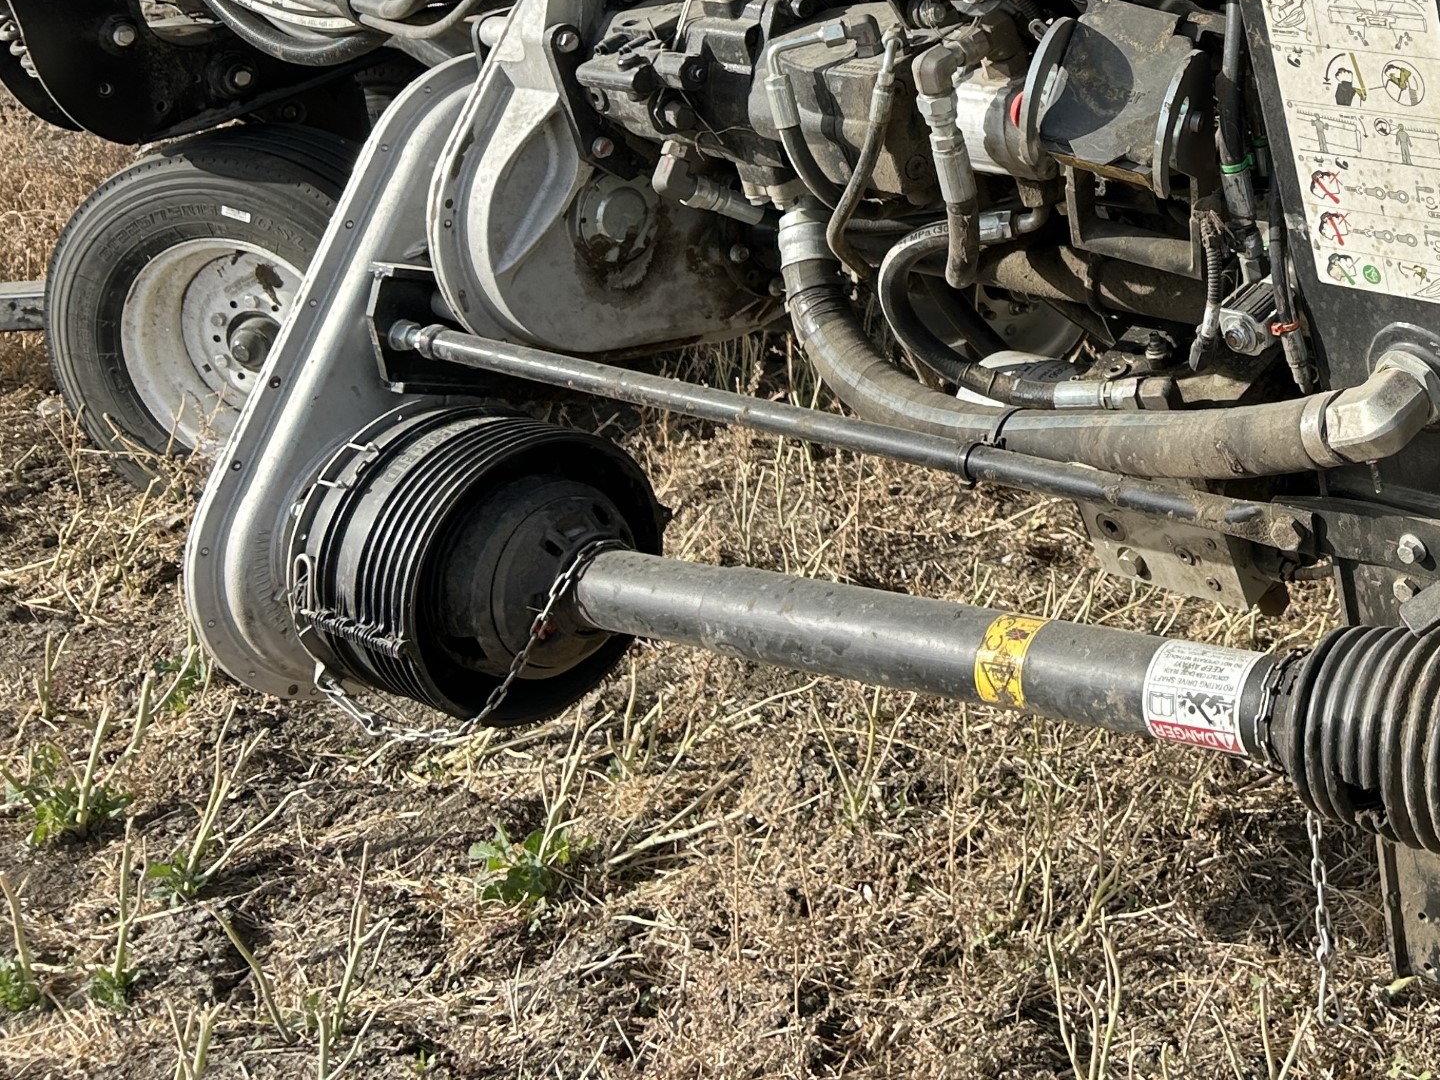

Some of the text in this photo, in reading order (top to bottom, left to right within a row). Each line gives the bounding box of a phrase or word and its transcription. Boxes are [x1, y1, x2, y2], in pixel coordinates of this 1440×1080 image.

[909, 230, 931, 242] MPa
[1193, 657, 1220, 665] OPERATE
[1173, 661, 1225, 674] KEEP AWAY!
[1153, 675, 1234, 692] ROTATING DRIVE SHAFT
[1206, 673, 1230, 682] CONTACT
[1154, 723, 1217, 746] DANGER
